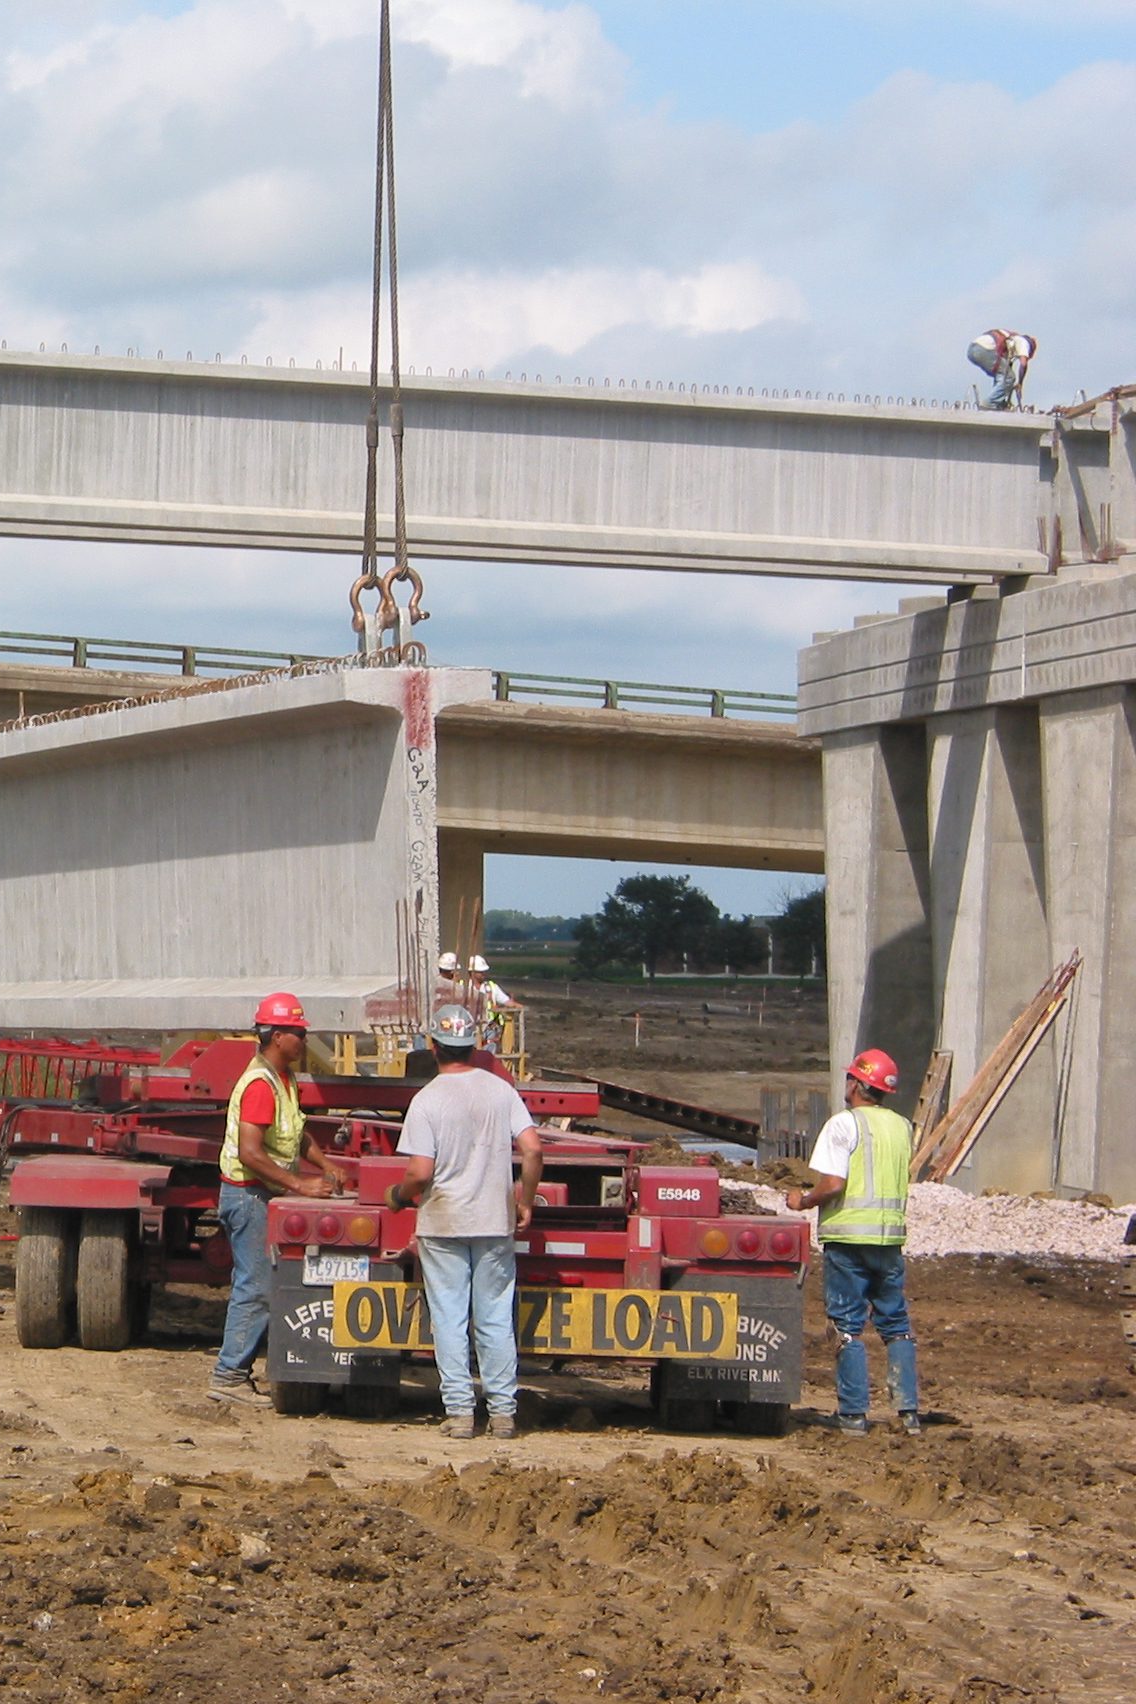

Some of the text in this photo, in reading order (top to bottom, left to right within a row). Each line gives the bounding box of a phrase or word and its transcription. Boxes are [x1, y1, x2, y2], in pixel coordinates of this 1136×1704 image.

[657, 1187, 701, 1201] E5848
[284, 1300, 334, 1331] LEFE
[593, 1293, 724, 1353] LOAD
[736, 1315, 787, 1350] BVRE
[688, 1367, 713, 1380] ELK
